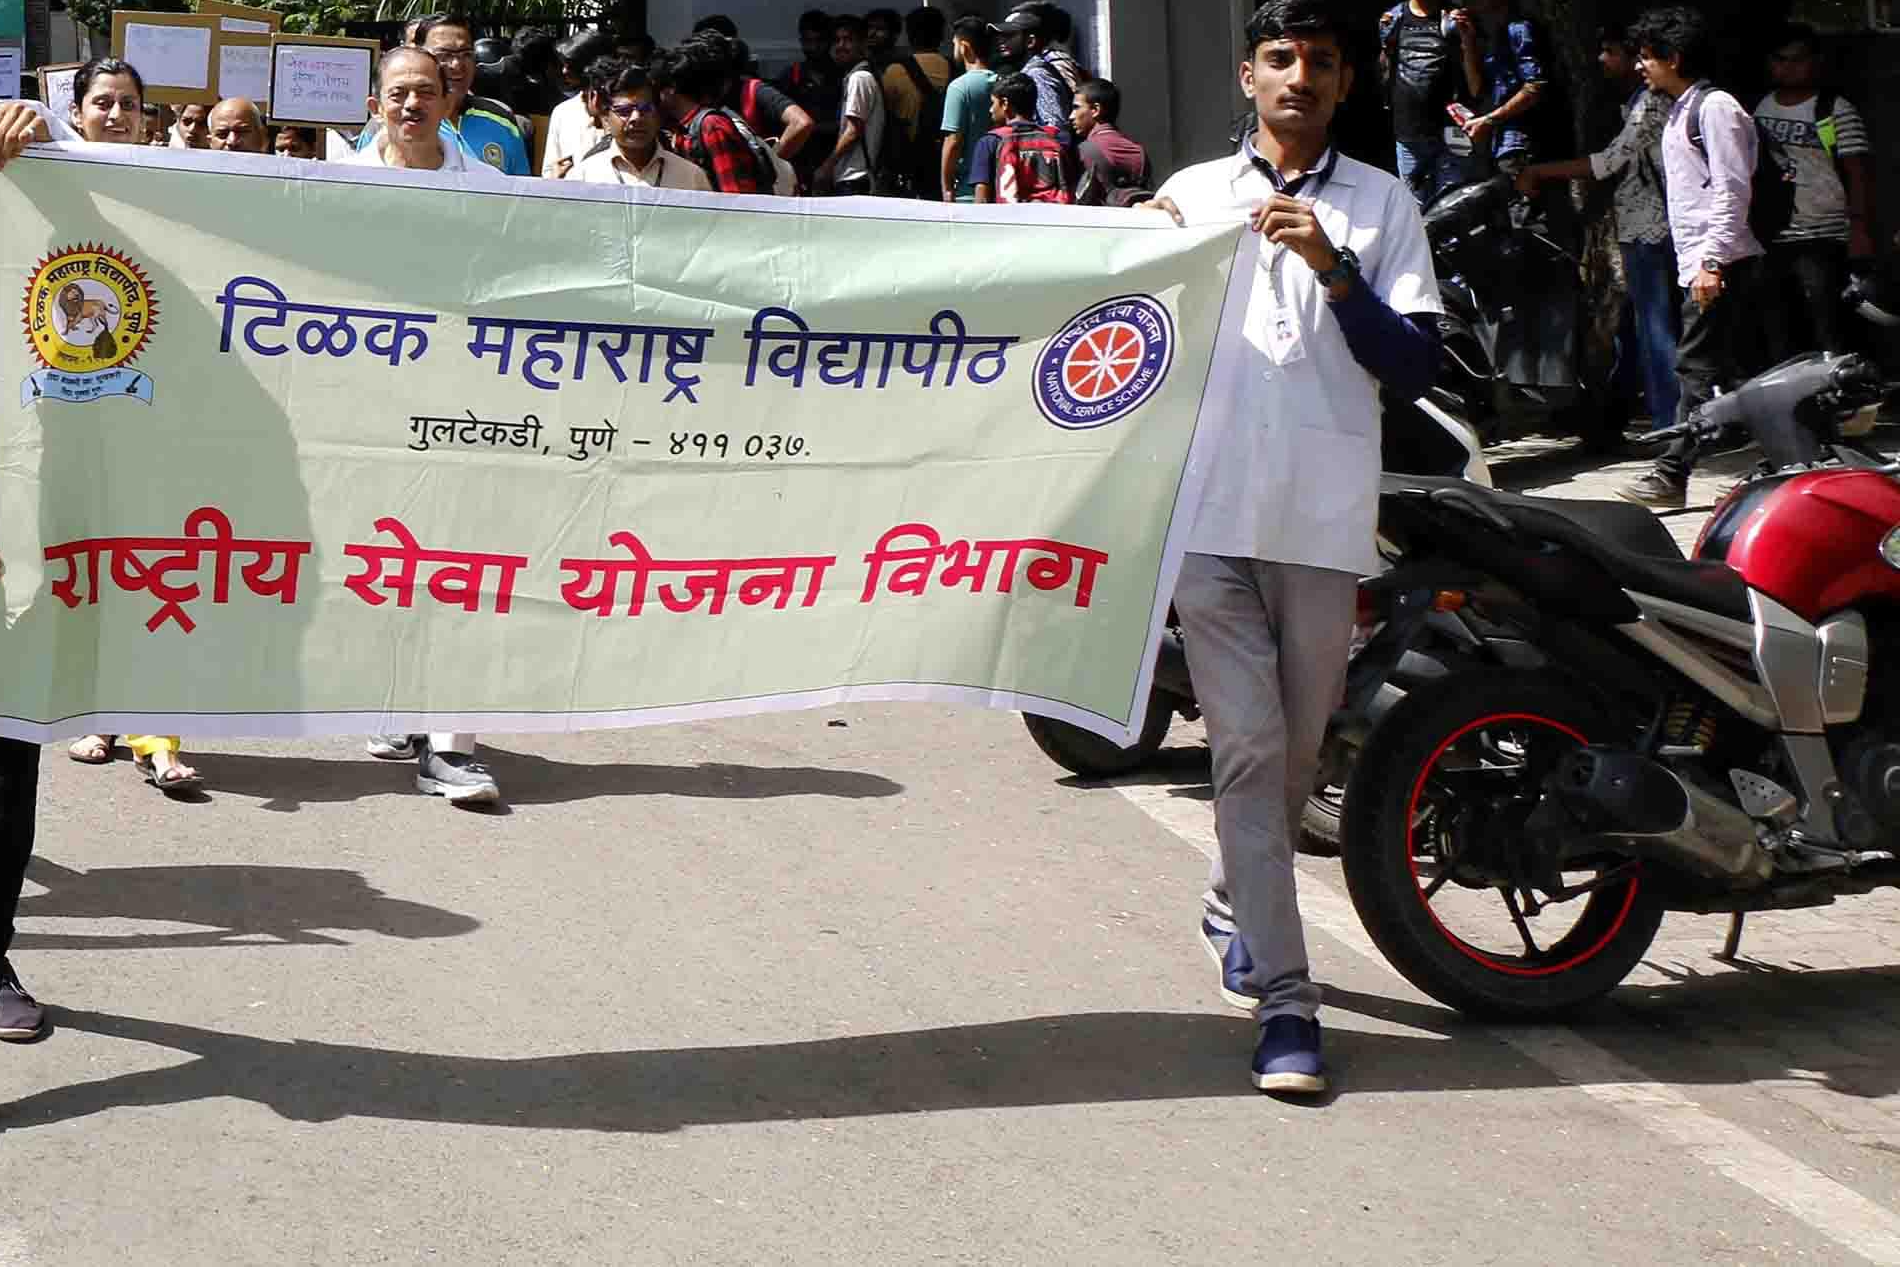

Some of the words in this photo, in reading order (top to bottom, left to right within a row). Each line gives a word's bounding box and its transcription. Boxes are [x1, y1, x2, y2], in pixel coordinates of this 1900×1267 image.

[216, 276, 437, 366] टिळक
[467, 316, 714, 403] महाराष्ट्र
[745, 307, 1019, 391] विद्यापीठ
[408, 409, 552, 456] गुलटेकडी,
[569, 418, 617, 461] पुणे
[667, 431, 731, 459] ४११
[1046, 371, 1076, 415] NATIONAL
[1074, 400, 1116, 418] SERVICE
[1115, 366, 1154, 407] SCHEME
[45, 507, 312, 634] राष्ट्रीय
[344, 516, 528, 615] सेवा
[560, 530, 836, 618] योजना
[861, 523, 1109, 609] विभाग
